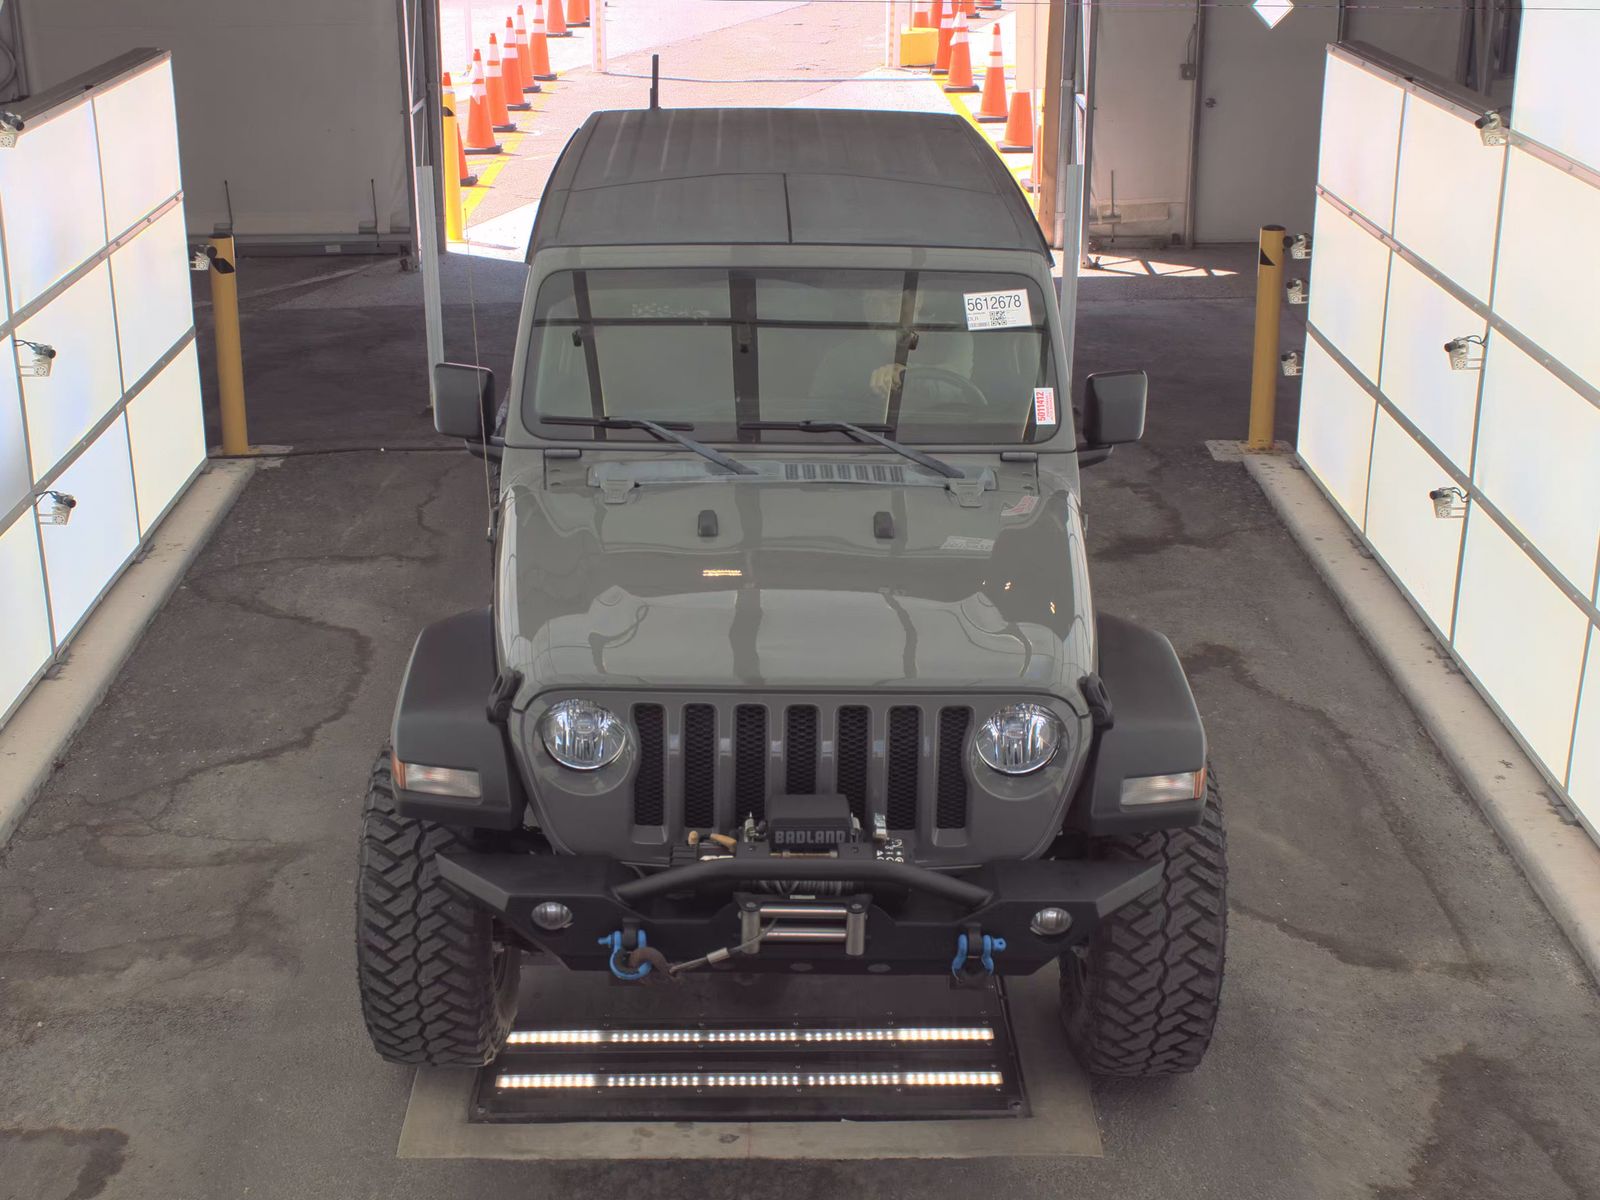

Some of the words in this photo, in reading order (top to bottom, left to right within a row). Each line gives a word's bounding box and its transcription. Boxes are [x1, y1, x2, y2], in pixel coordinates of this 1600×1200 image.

[967, 295, 1021, 311] 5612678
[1036, 391, 1046, 421] 5011412
[775, 830, 846, 844] BADLAND
